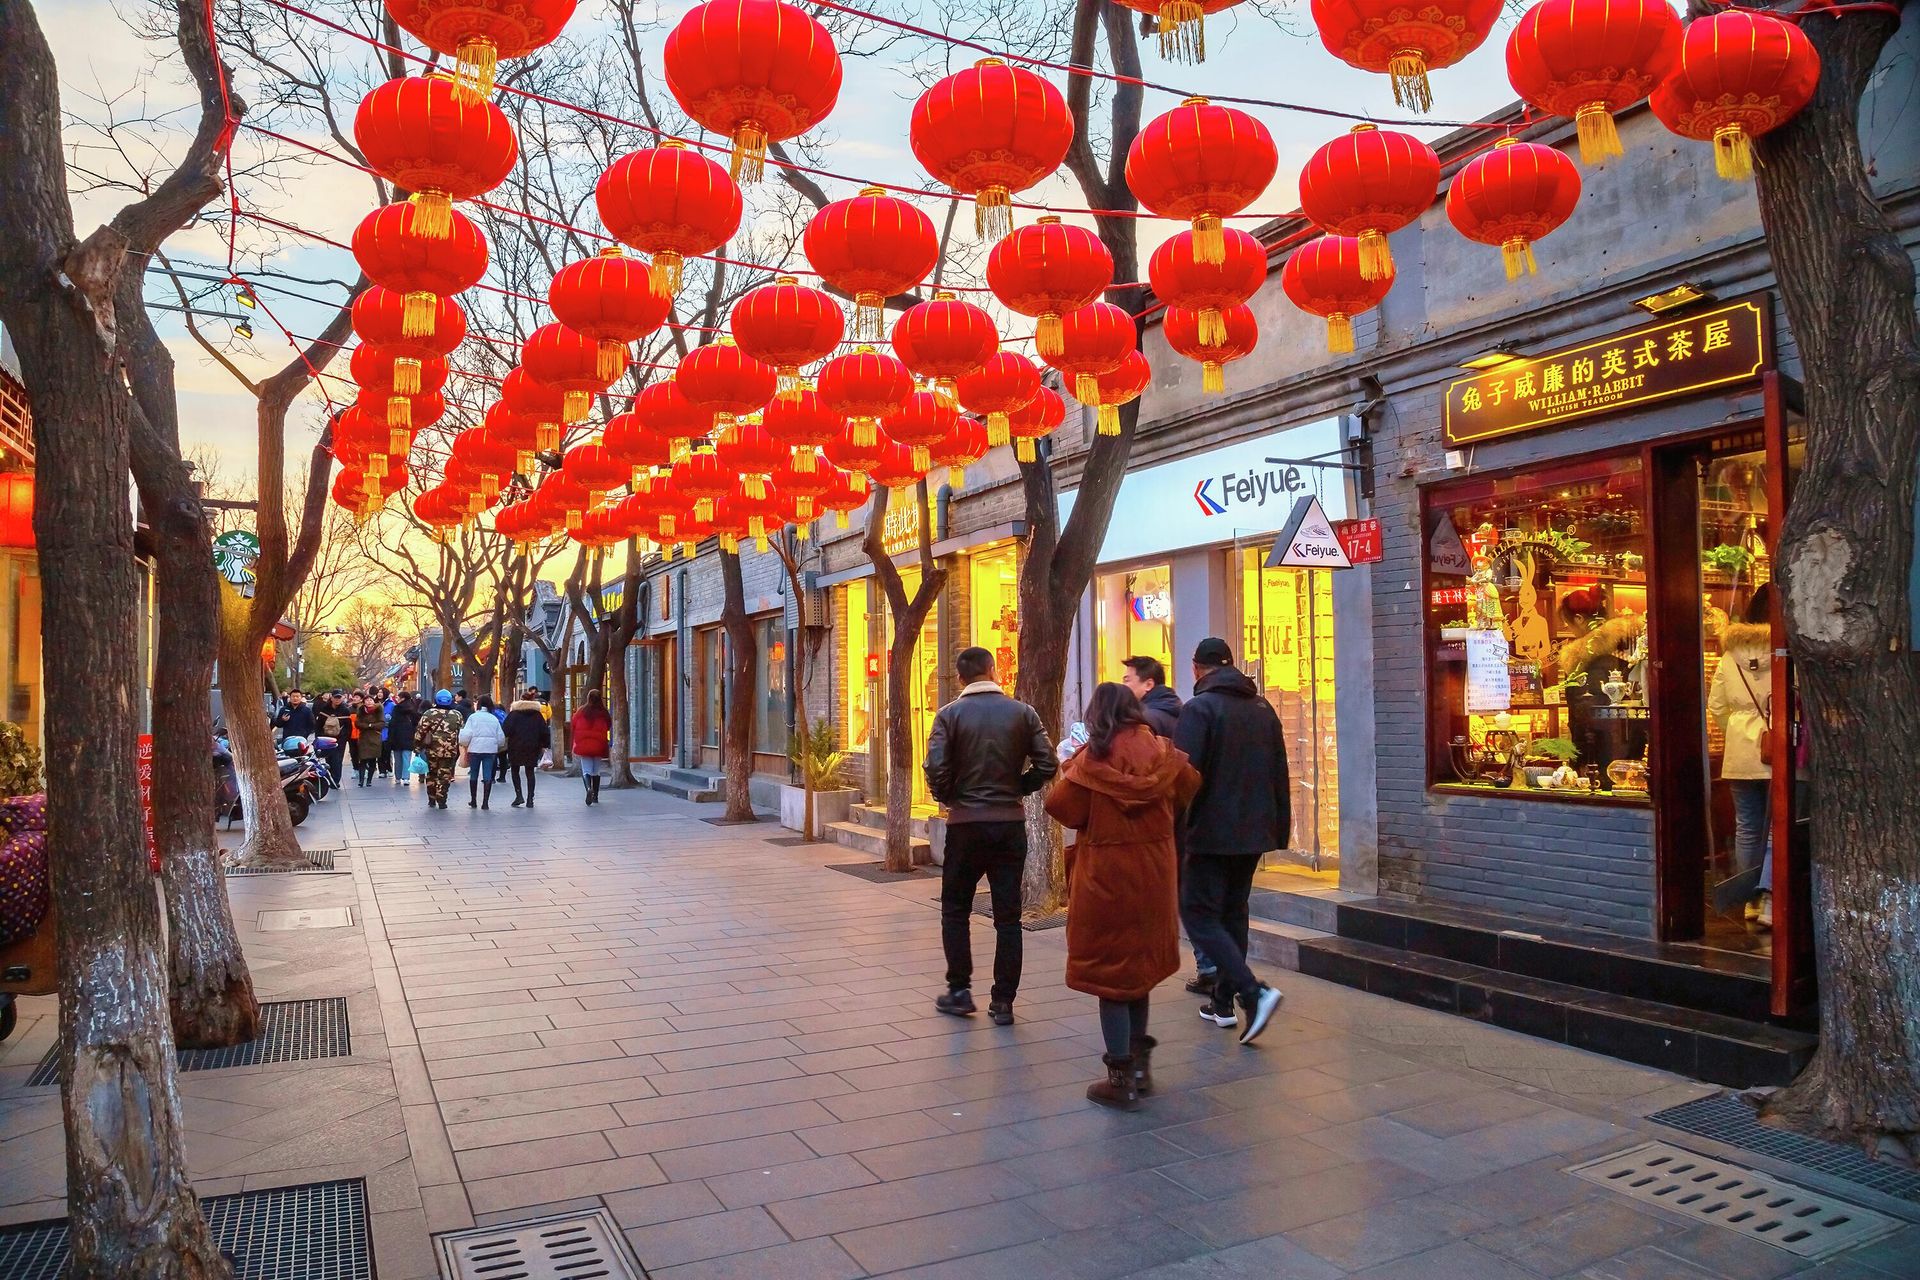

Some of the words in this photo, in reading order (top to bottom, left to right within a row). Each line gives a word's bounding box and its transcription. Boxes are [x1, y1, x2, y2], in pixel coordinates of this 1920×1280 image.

[1461, 319, 1732, 413] 兔子威廉的英式茶屋
[1546, 402, 1579, 415] BRITISH
[1582, 392, 1623, 407] TEAROOM
[1222, 466, 1306, 507] Feiyue.
[1305, 544, 1340, 558] Feiyue.
[1347, 539, 1372, 559] 17-4
